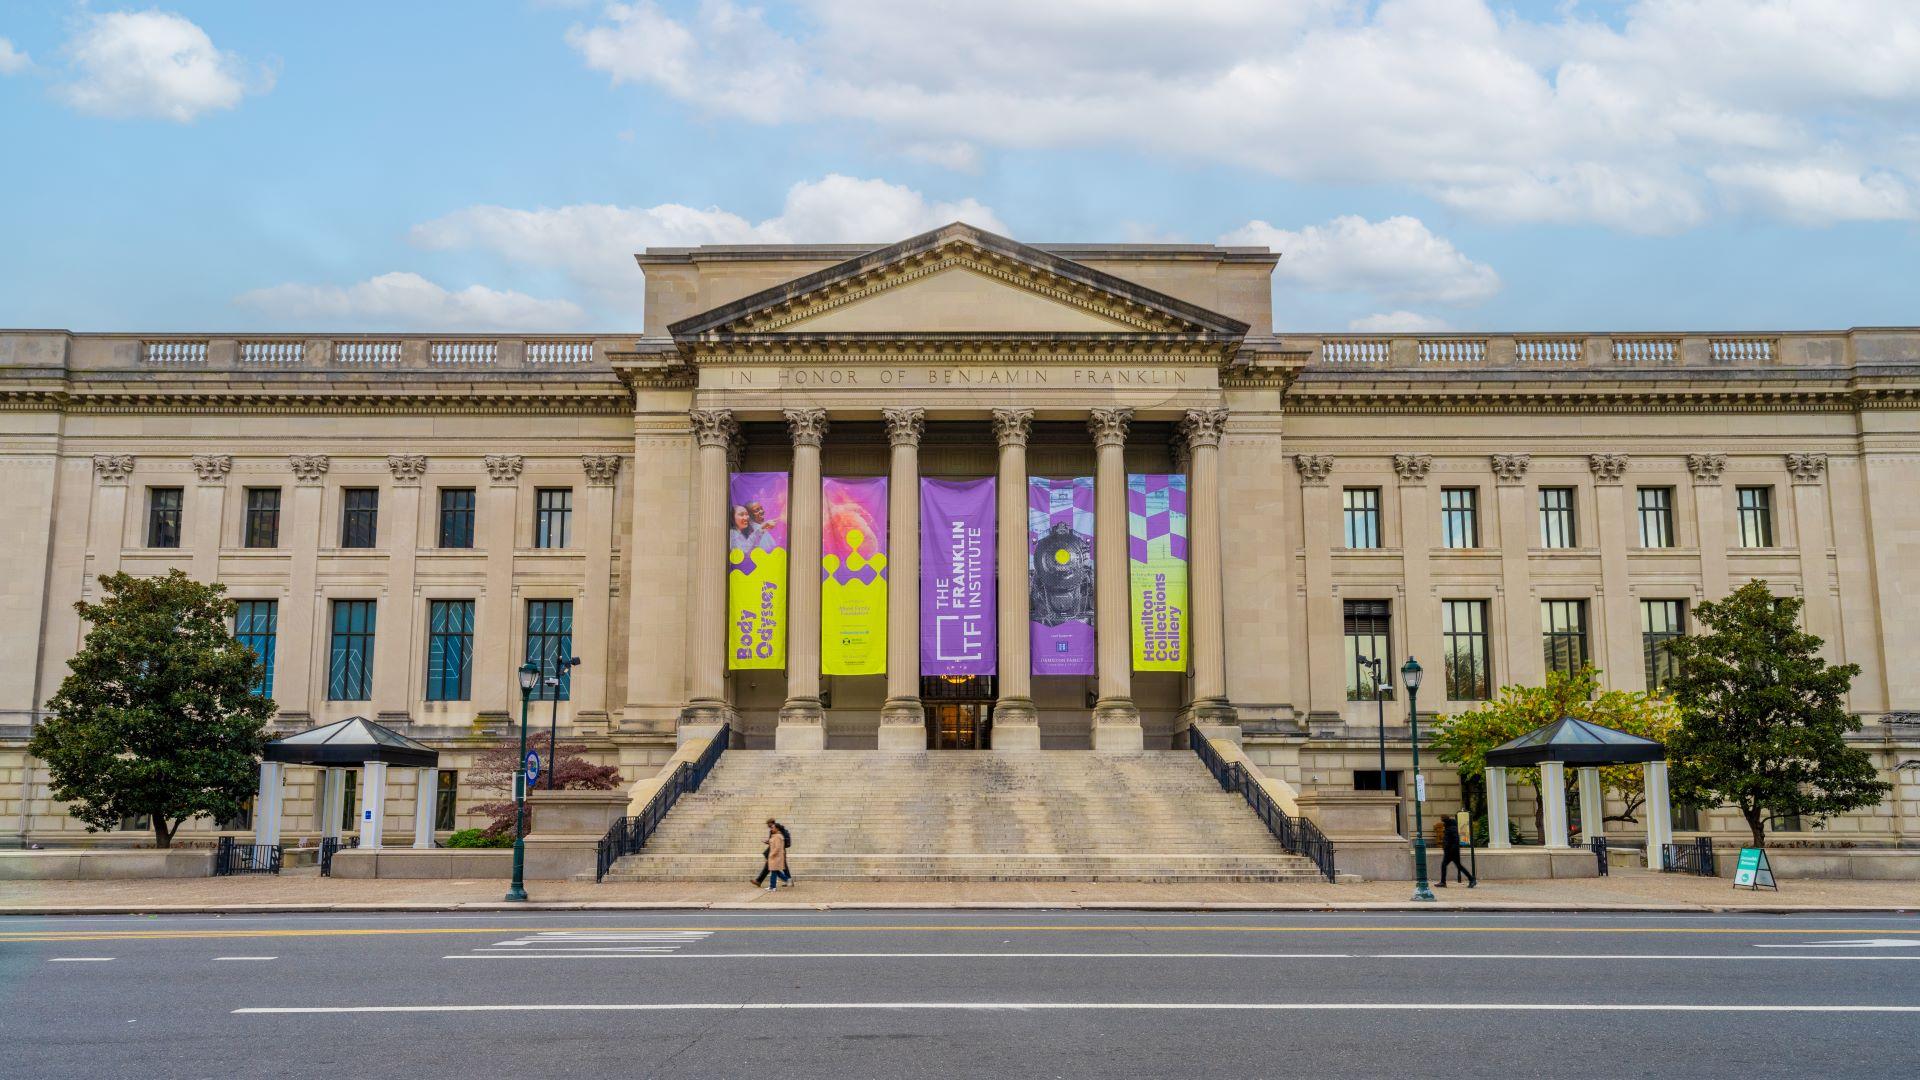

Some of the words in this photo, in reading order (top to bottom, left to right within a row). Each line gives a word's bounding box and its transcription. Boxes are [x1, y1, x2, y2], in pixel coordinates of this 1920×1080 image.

[730, 371, 752, 385] IN
[778, 370, 858, 384] HONOR
[880, 370, 906, 384] OF
[929, 370, 1048, 384] BENJAMIN
[1074, 370, 1187, 384] FRANKLIN
[937, 578, 949, 610] THE
[952, 521, 965, 609] FRANKLIN
[969, 527, 982, 608] INSTITUTE
[736, 609, 757, 660] Body
[756, 581, 778, 659] Odyssey
[963, 614, 982, 654] TFI
[1141, 590, 1154, 662] Hamilton
[1154, 573, 1168, 662] Collections
[1168, 606, 1182, 662] Gallery
